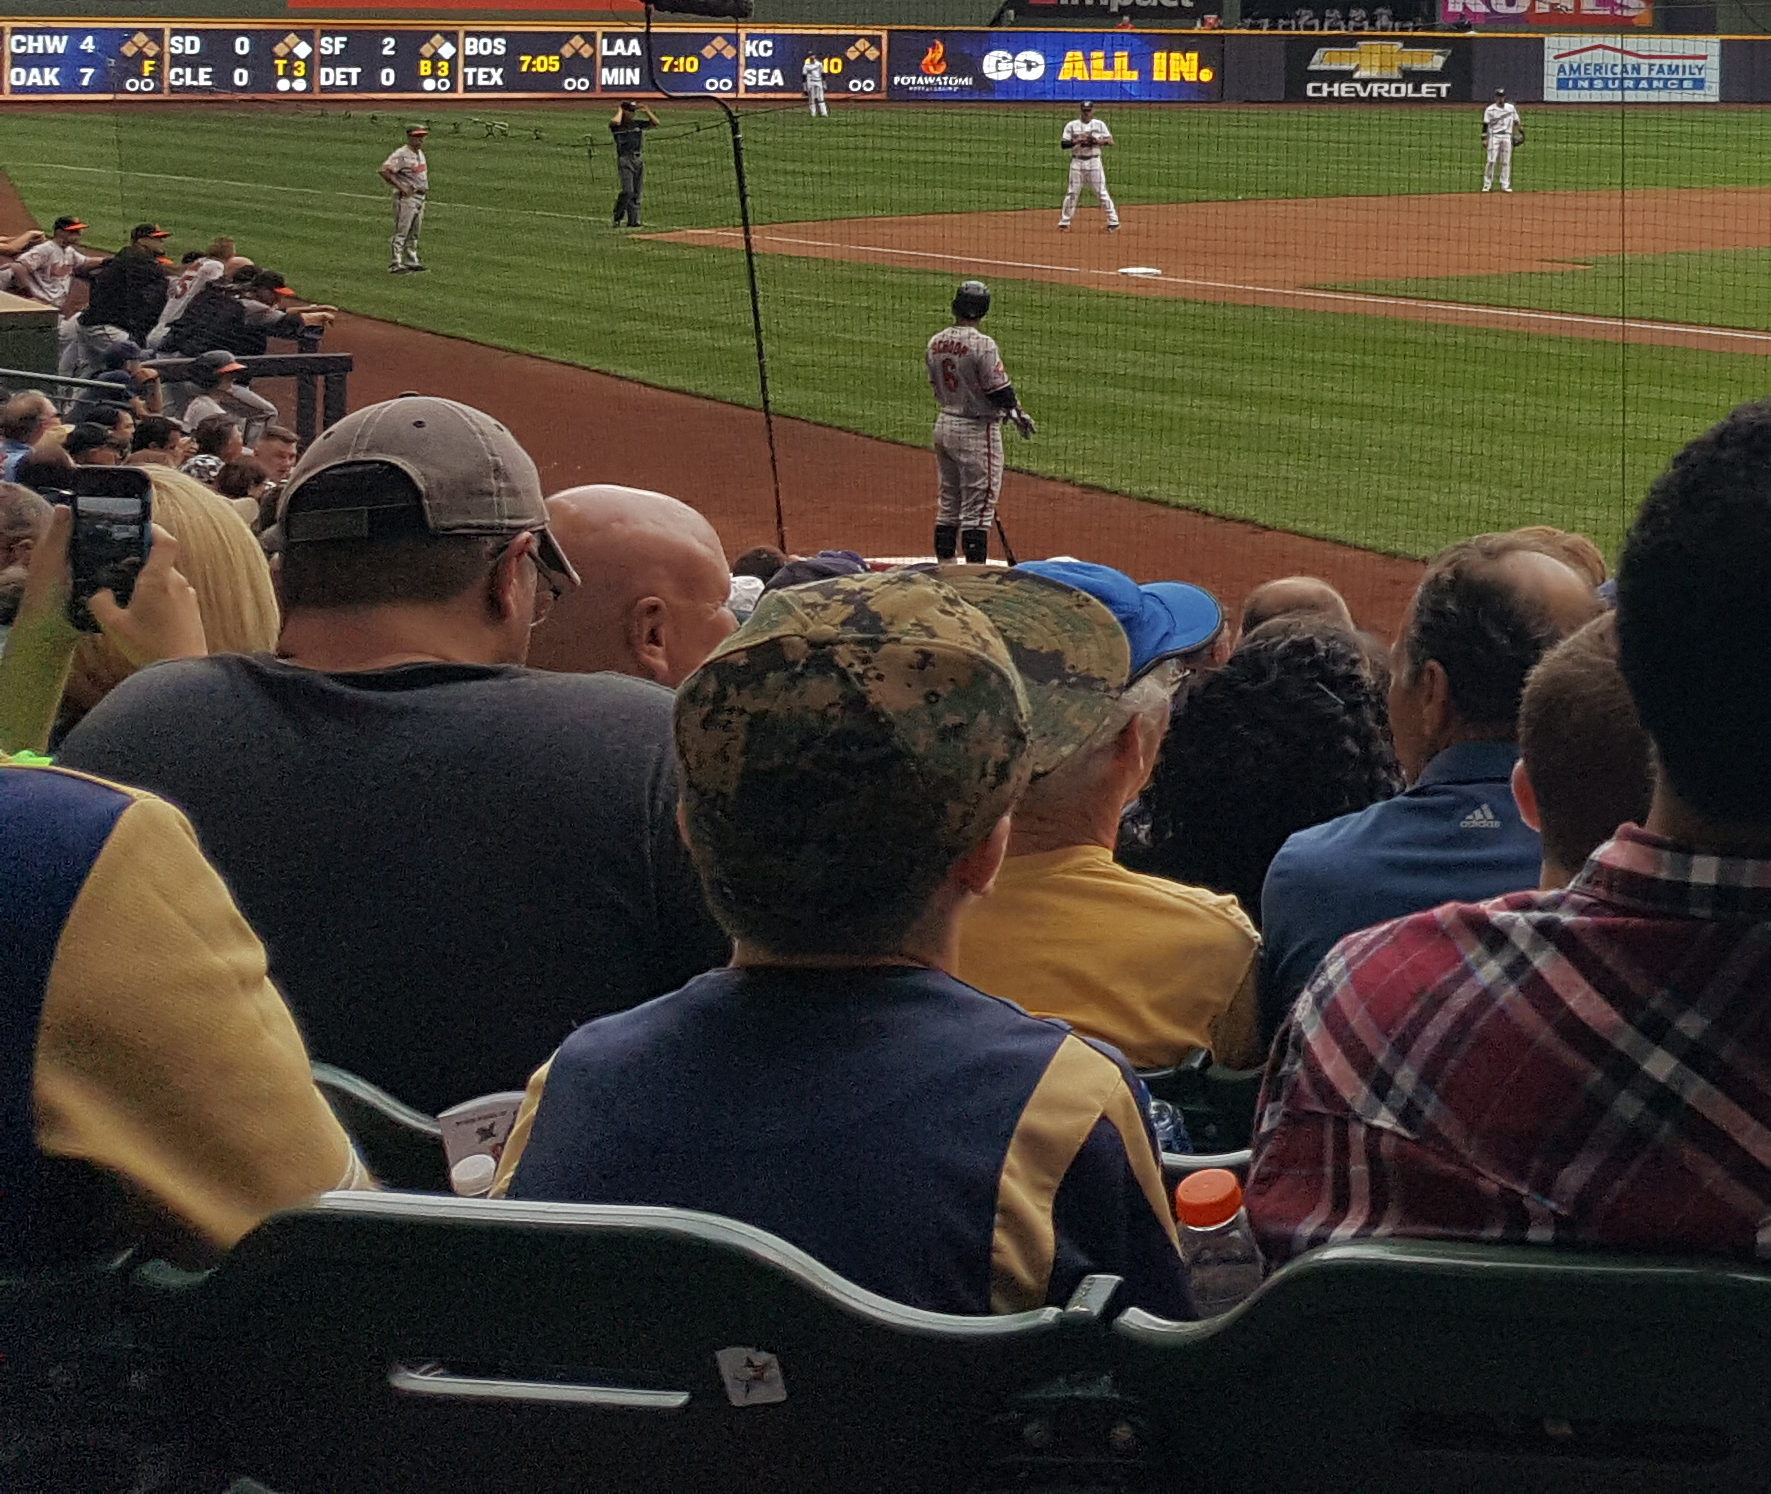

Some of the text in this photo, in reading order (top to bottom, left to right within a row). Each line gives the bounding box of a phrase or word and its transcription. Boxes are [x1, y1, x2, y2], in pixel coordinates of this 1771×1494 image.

[10, 35, 68, 55] CHW
[464, 37, 506, 56] BOS
[519, 55, 560, 74] 7:05
[983, 50, 1213, 83] GO ALL IN.
[9, 68, 60, 86] OAK
[464, 69, 503, 87] TEX
[1306, 82, 1451, 98] CHEVROLET
